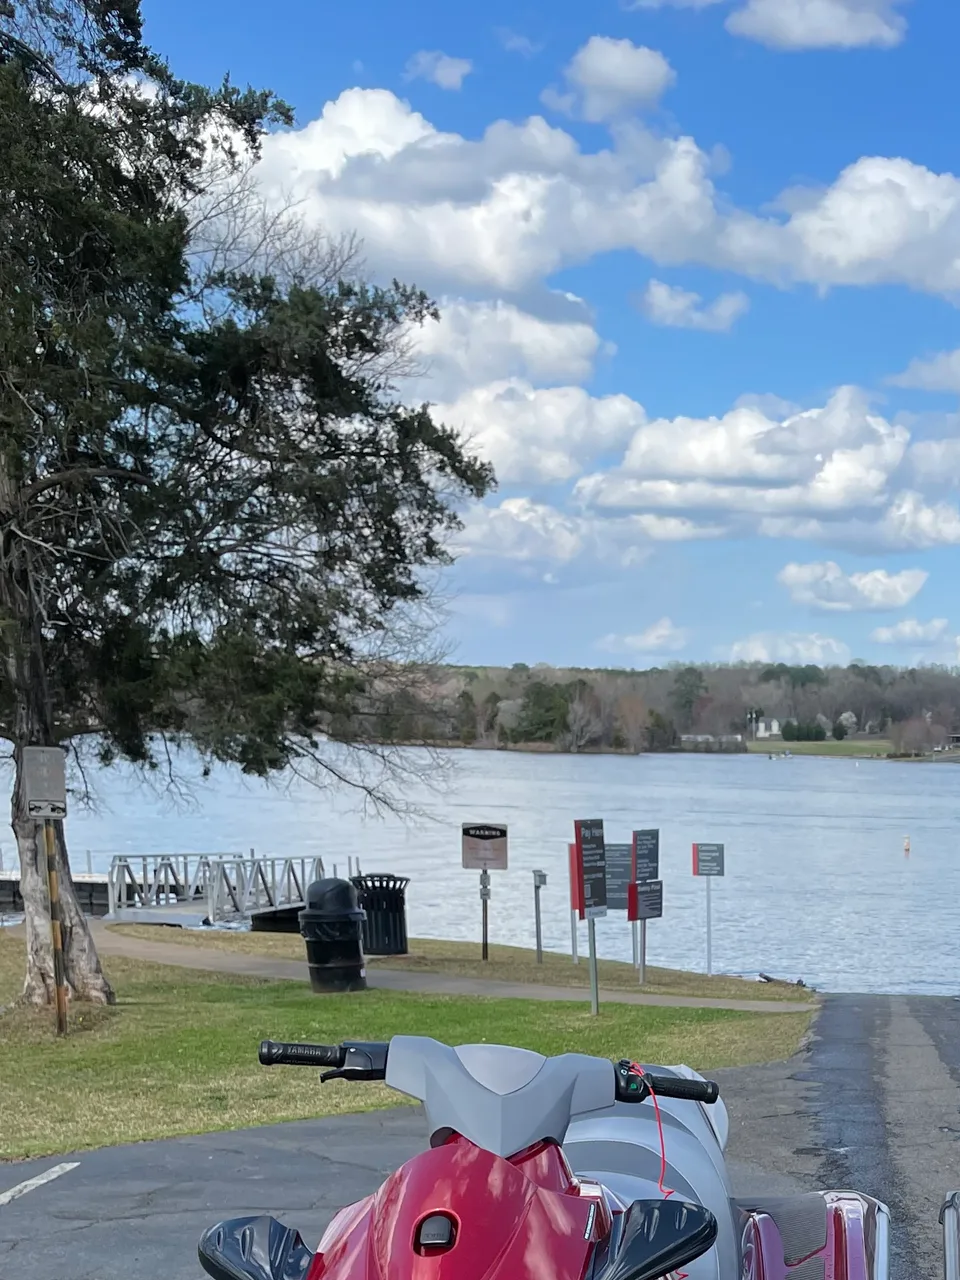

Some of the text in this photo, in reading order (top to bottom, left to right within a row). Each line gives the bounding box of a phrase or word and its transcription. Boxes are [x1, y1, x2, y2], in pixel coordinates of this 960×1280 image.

[468, 829, 502, 837] WARNING
[581, 827, 591, 839] Pay
[287, 1046, 321, 1056] YAMAHA
